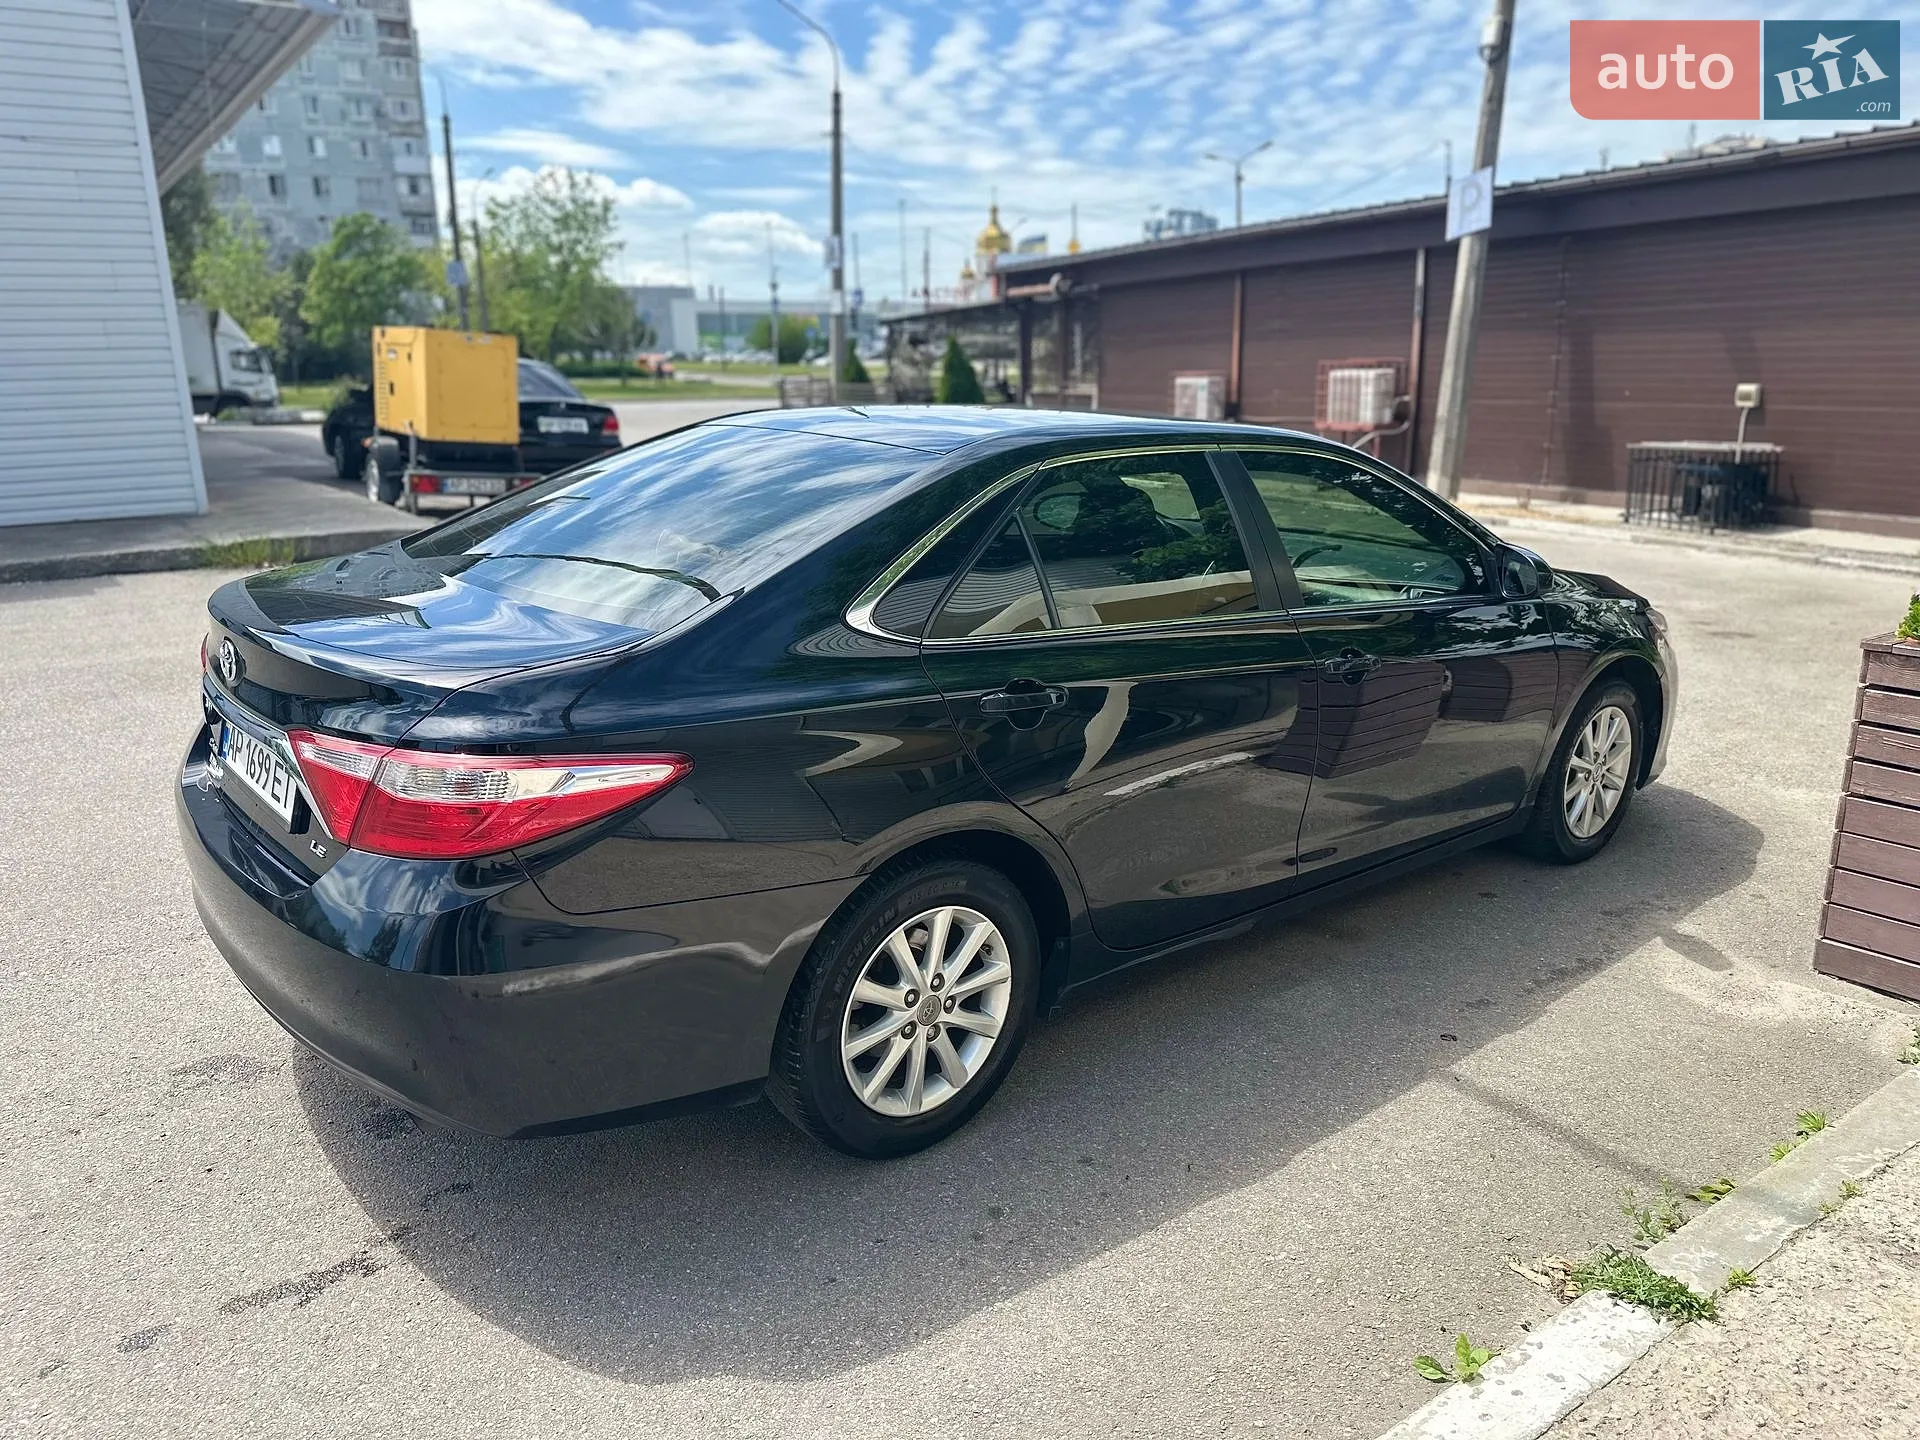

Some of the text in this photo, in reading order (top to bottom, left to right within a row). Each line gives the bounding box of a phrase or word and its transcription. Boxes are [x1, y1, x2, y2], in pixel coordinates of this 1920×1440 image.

[228, 727, 244, 764] AP
[246, 738, 271, 790] 1699
[309, 839, 327, 859] LE
